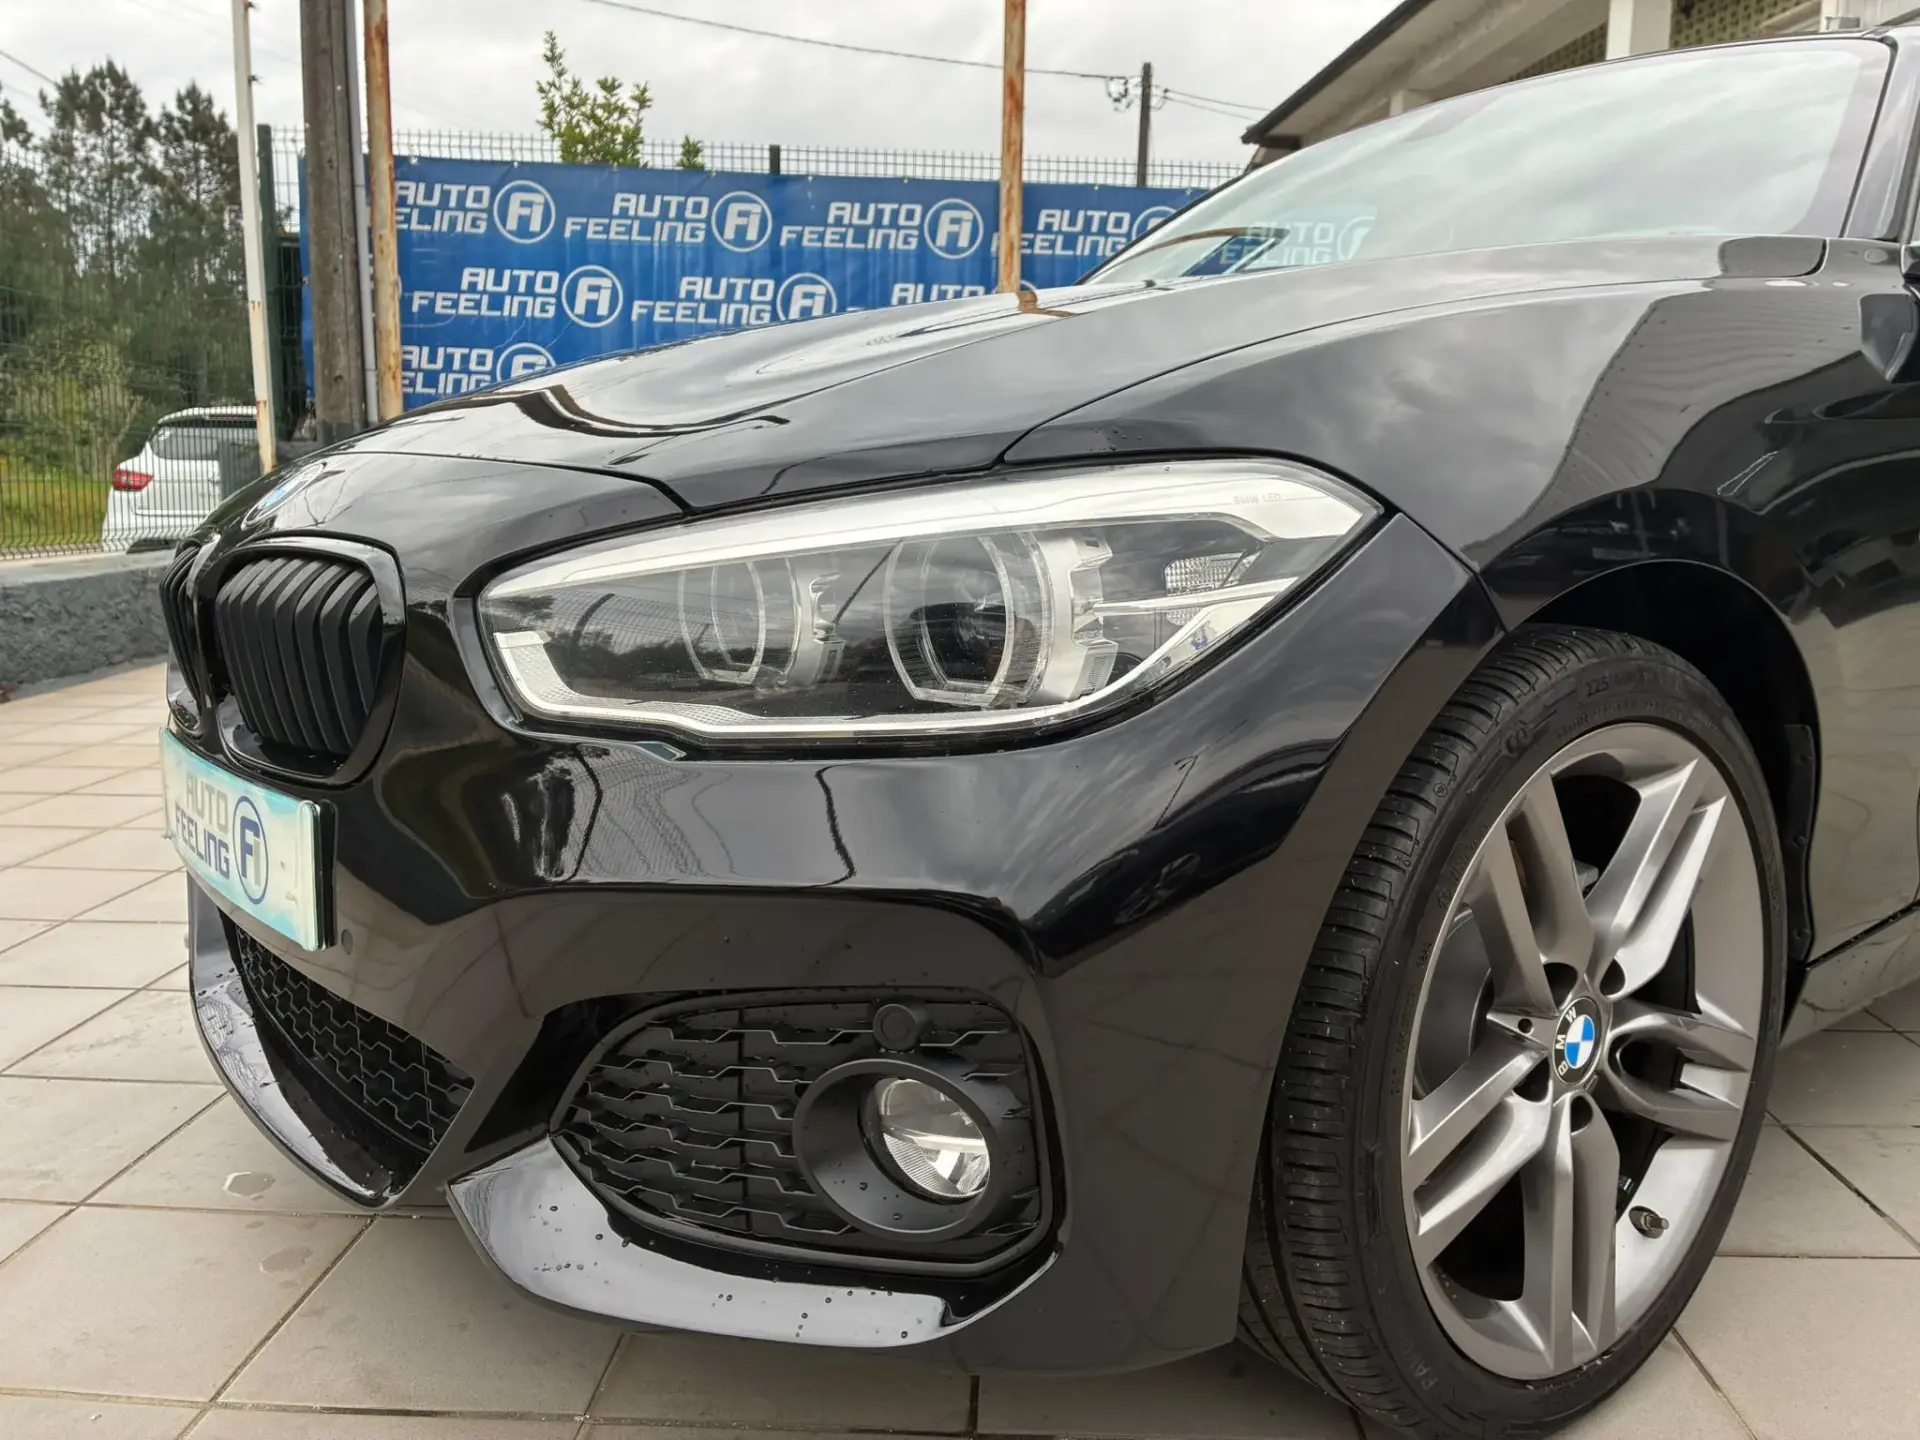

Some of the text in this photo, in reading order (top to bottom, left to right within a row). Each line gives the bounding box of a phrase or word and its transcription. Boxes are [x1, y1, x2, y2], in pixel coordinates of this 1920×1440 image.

[395, 180, 491, 209] AUTO
[612, 192, 709, 219] AUTO
[395, 207, 487, 233] ELING
[827, 202, 922, 226] AUTO
[1037, 209, 1131, 233] AUTO
[564, 217, 707, 243] FEELING
[780, 225, 919, 250] FEELING
[461, 267, 559, 294] AUTO
[679, 276, 775, 301] AUTO
[411, 290, 556, 318] FEELING
[631, 300, 772, 325] FEELING
[402, 345, 494, 371] AUTO
[1262, 492, 1282, 503] LED
[186, 775, 229, 834] AUTO
[175, 802, 230, 880] FEELING
[1555, 1006, 1577, 1077] BMW
